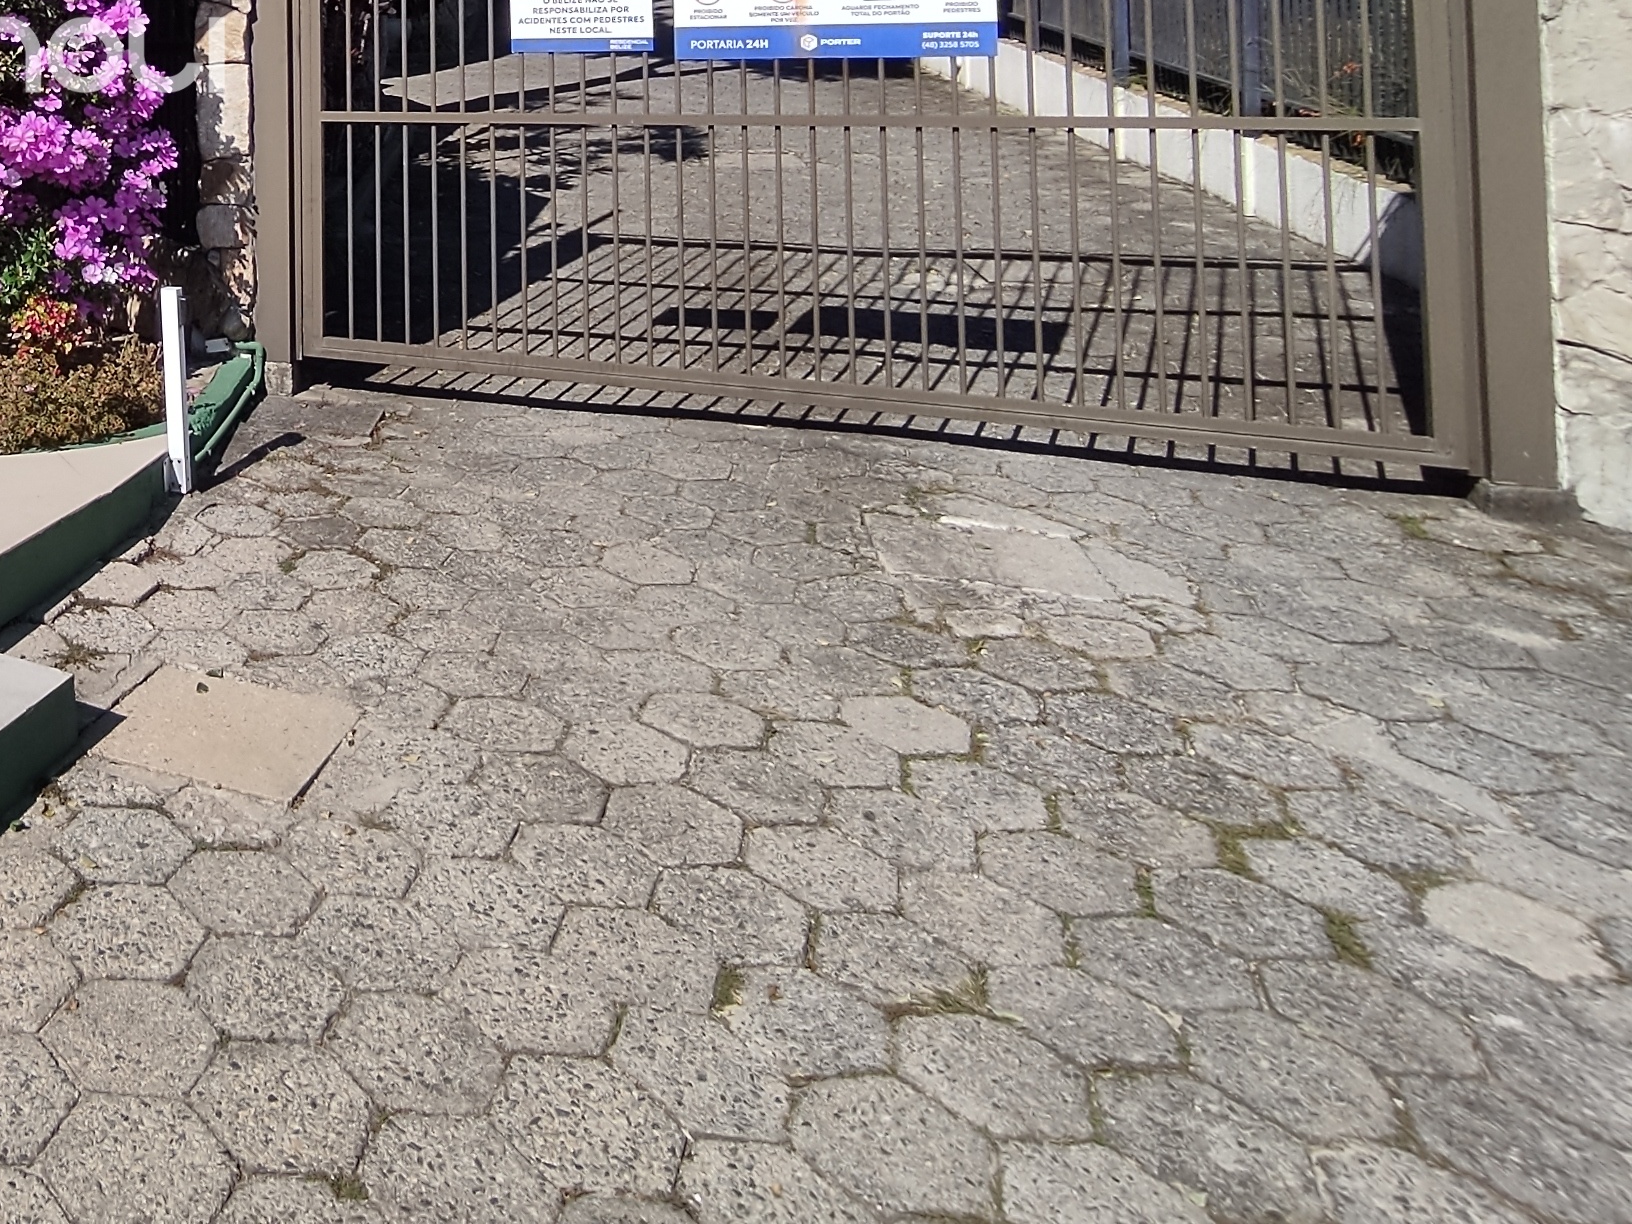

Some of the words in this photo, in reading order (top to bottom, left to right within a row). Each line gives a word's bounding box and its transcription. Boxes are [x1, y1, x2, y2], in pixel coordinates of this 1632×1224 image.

[922, 31, 962, 39] SUPORTE
[690, 39, 745, 49] PORTARIA
[745, 39, 769, 48] 24H
[820, 38, 861, 46] PORTER
